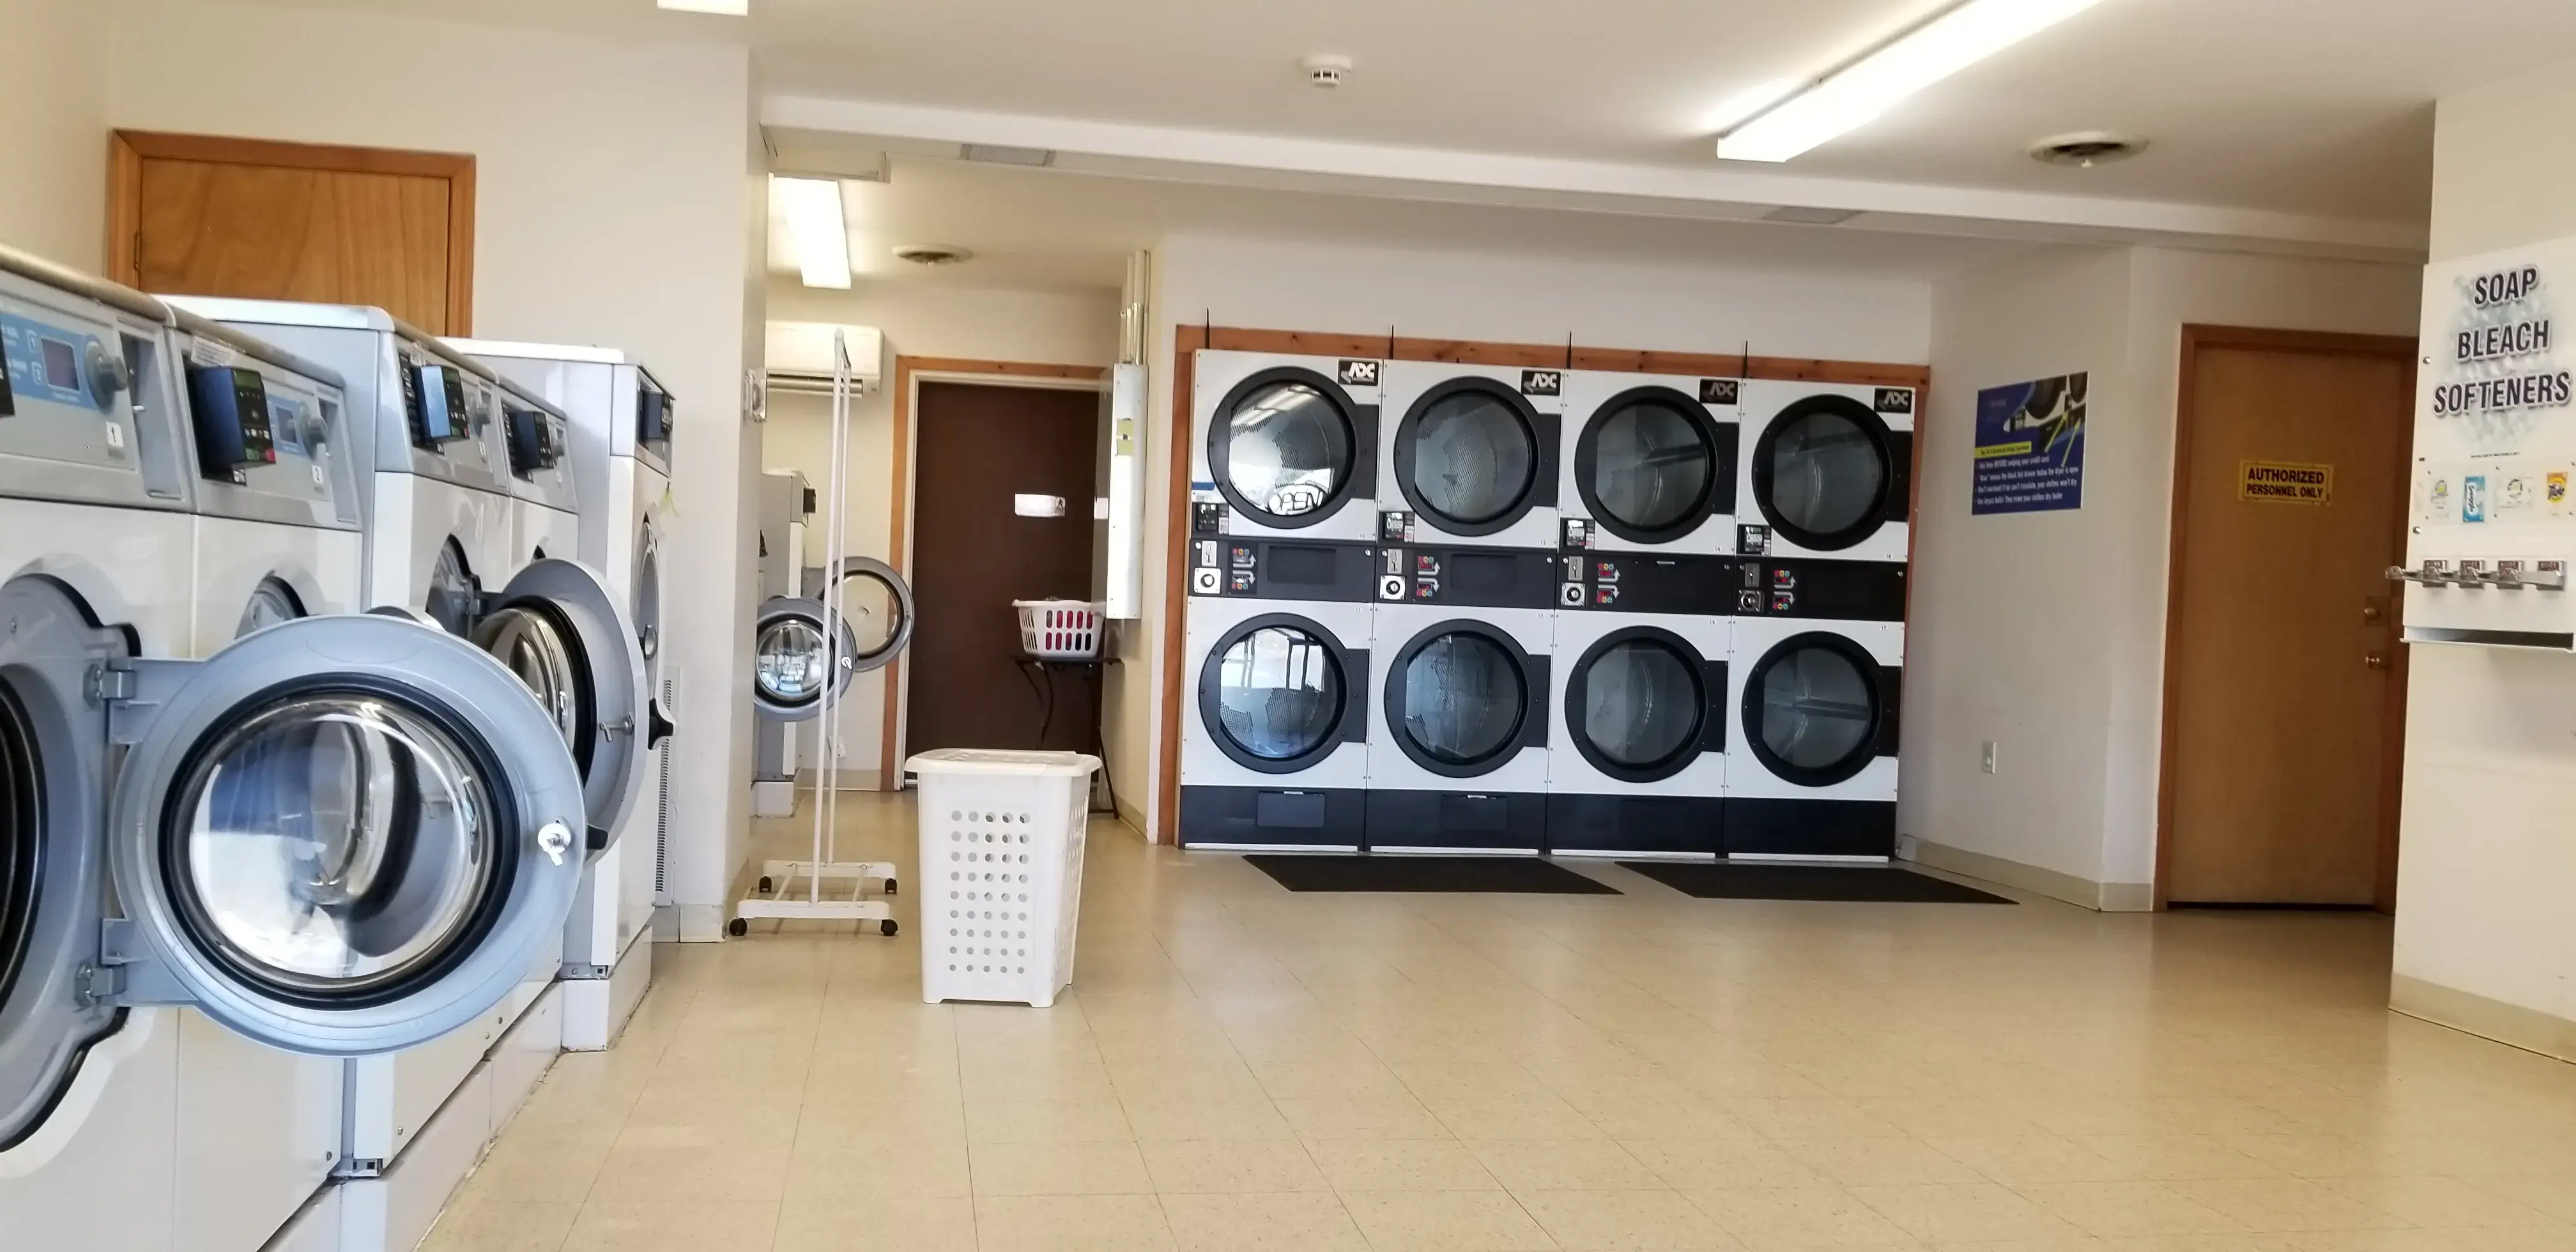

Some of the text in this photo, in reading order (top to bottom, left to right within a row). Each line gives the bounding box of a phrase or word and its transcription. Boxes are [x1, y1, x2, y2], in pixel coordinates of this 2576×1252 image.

[2473, 266, 2538, 307] SOAP
[2457, 319, 2550, 361] BLEACH
[1348, 362, 1375, 379] ADC
[1531, 372, 1557, 388] ADC
[1709, 381, 1735, 397] ADC
[1883, 390, 1909, 405] ADC
[2432, 370, 2572, 415] SOFTENERS
[2248, 467, 2325, 484] AUTHORIZED
[2246, 483, 2324, 498] PERSONNEL ONLY
